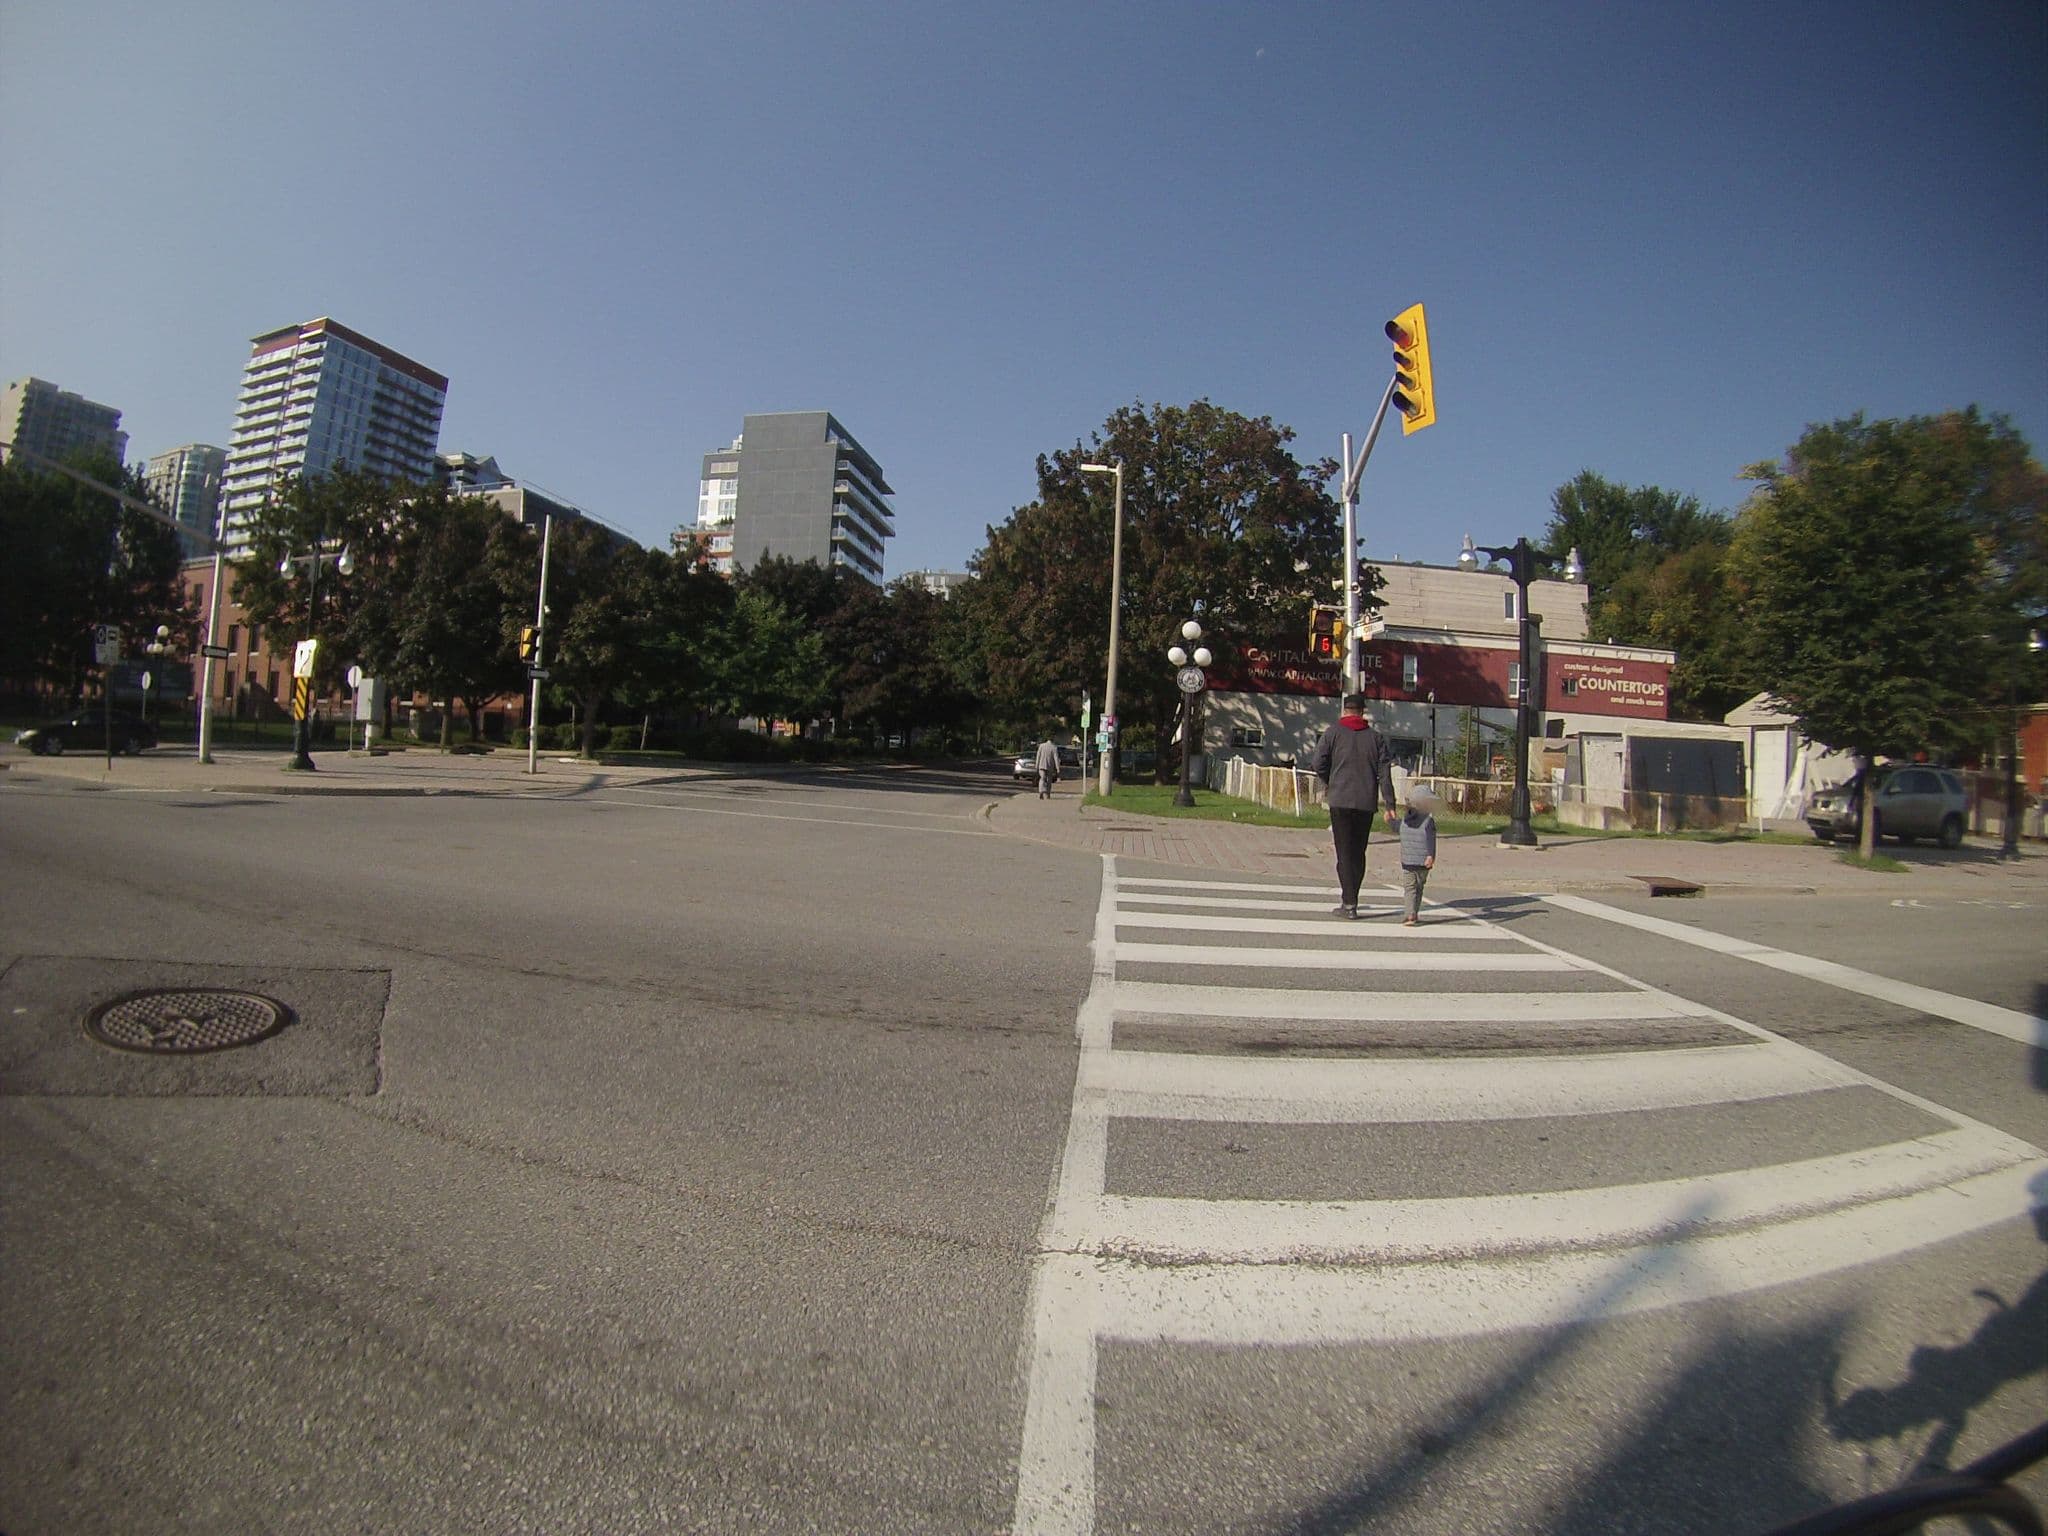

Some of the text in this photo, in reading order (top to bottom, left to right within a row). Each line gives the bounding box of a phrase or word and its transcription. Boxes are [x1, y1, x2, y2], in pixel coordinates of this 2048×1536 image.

[1247, 647, 1308, 664] CAPITAL
[1564, 663, 1624, 674] custom designed
[1578, 677, 1665, 696] COUNTERTOPS
[1610, 696, 1625, 704] and
[1625, 697, 1645, 705] much
